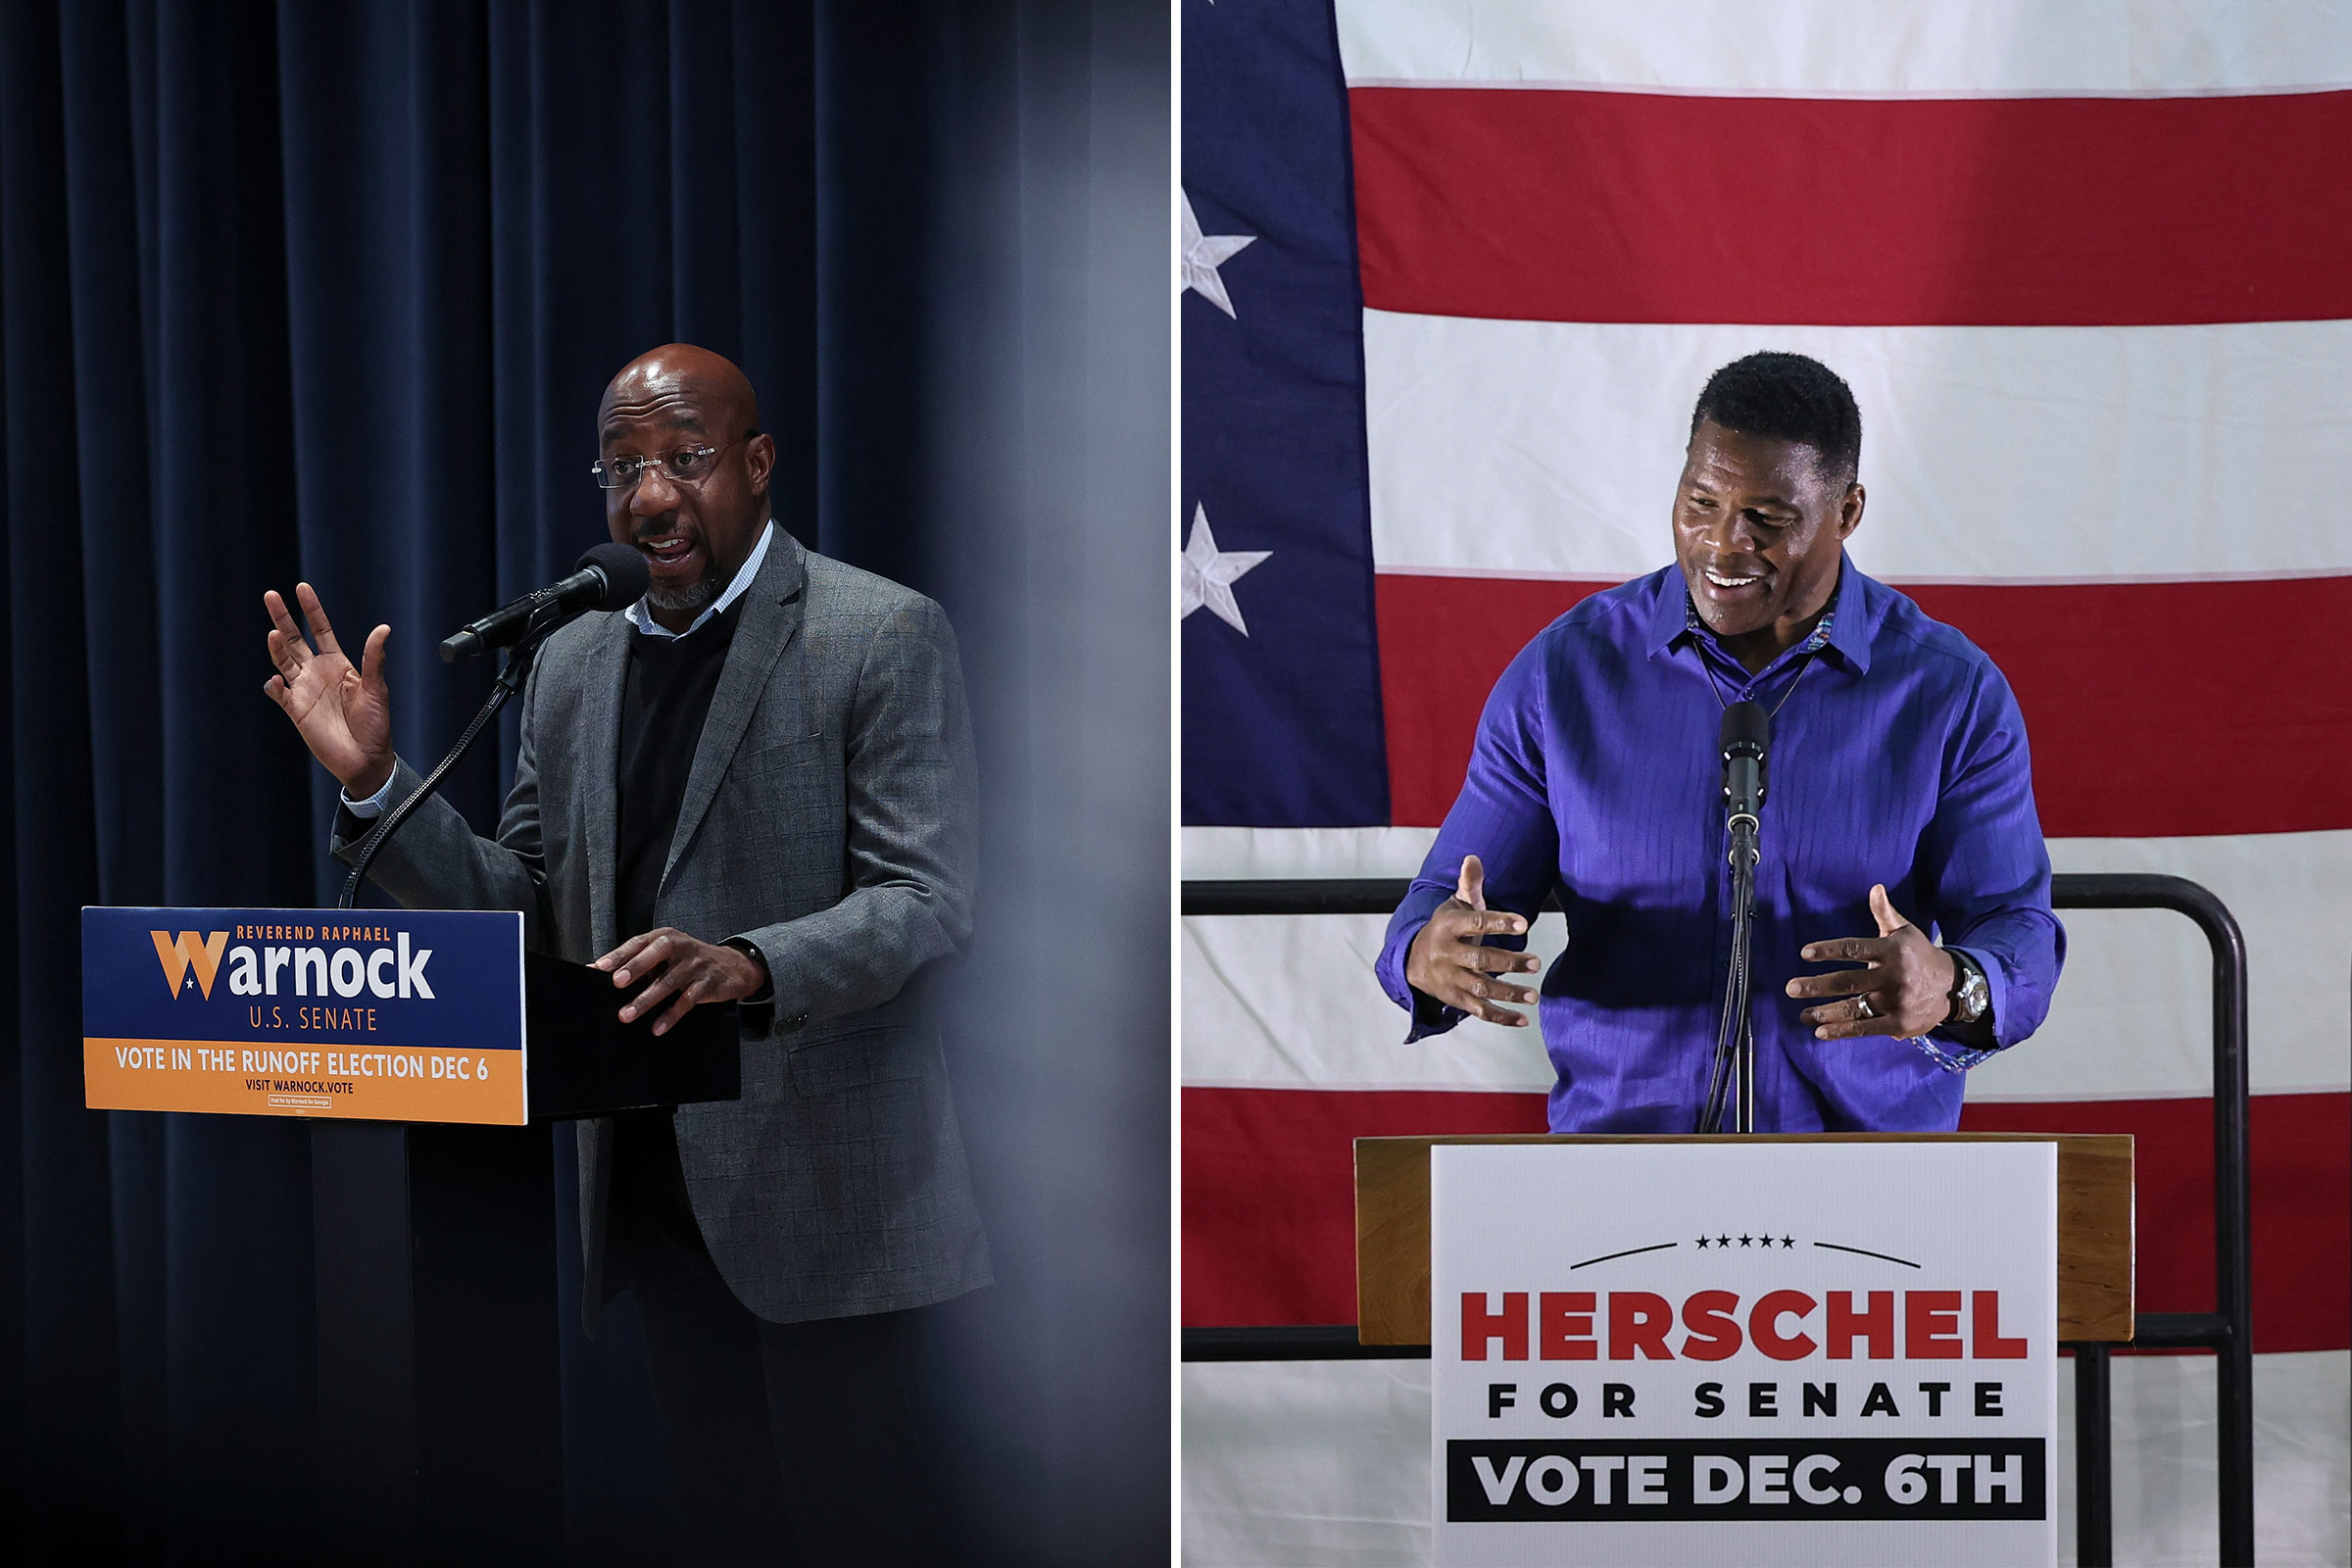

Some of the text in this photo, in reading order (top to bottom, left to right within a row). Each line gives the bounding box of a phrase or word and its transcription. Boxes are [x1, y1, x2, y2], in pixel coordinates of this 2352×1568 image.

[236, 924, 391, 942] REVEREND RAPHAEL
[150, 930, 436, 1002] Warnock
[250, 1005, 377, 1032] U.S. SENATE
[115, 1046, 488, 1081] VOTE IN THE RUNOFF ELECTION DEC 6
[245, 1079, 354, 1095] VISIT WARNOCK.VOTE
[1461, 1290, 2028, 1361] HERSCHEL
[1489, 1382, 2004, 1419] FOR SENATE
[1472, 1454, 2024, 1505] VOTE DEC. 6TH
